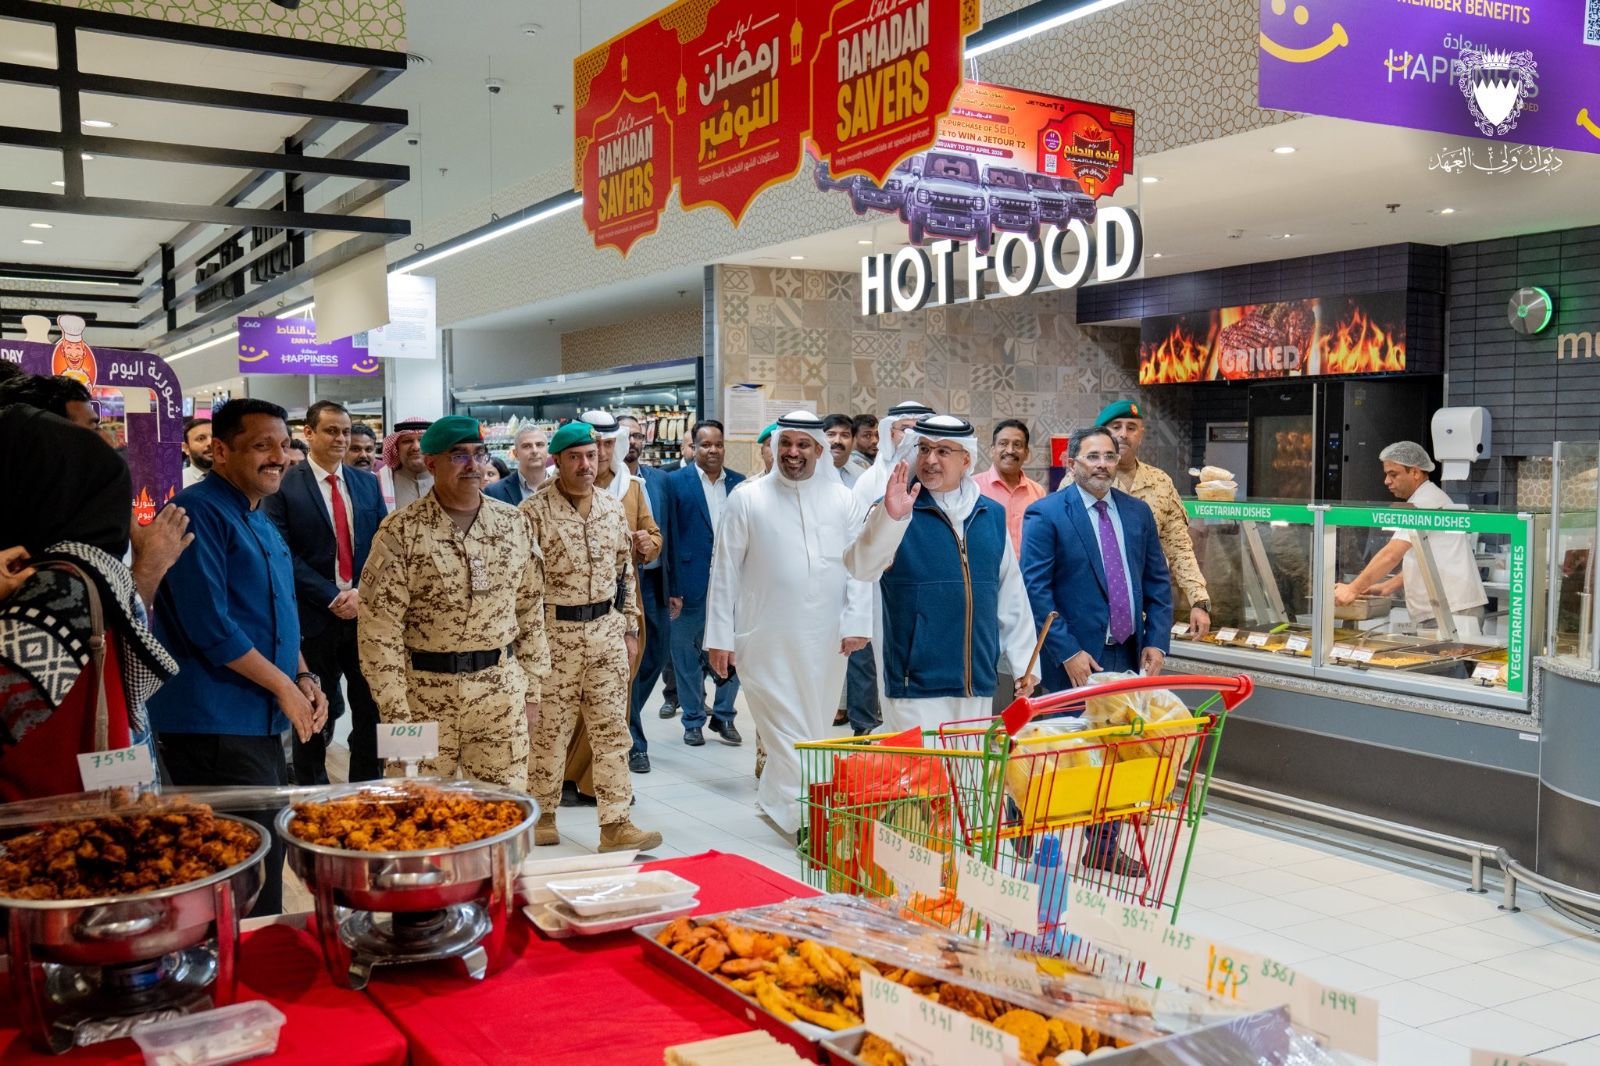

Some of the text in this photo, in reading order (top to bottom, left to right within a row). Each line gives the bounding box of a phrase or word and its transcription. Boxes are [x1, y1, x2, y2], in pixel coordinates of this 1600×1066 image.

[1466, 0, 1530, 24] BENEFITS
[724, 14, 752, 48] لولو
[838, 0, 929, 83] RAMADAN
[699, 36, 779, 106] رمضان
[837, 51, 929, 142] SAVERS
[699, 78, 779, 163] التوفير
[949, 120, 981, 131] PURCHASE
[598, 124, 653, 178] RAMADAN
[958, 130, 976, 141] WIN
[983, 135, 1015, 148] JETOUR
[1016, 140, 1026, 149] T2
[976, 146, 991, 154] APRIL
[598, 161, 654, 222] SAVERS
[862, 206, 1143, 316] HOT FOOD
[281, 354, 338, 364] HAPPINESS
[1221, 345, 1300, 373] GRILLED
[109, 359, 181, 419] شوربة اليوم
[1194, 504, 1271, 518] VEGETARIAN DISHES
[1372, 511, 1471, 528] VEGETARIAN DISHES
[1511, 545, 1524, 680] VEGETARIAN DISHES
[390, 725, 423, 738] 1081
[91, 749, 136, 768] 7598
[908, 845, 932, 866] 5871
[1000, 879, 1030, 902] 5872
[1075, 889, 1106, 916] 6304
